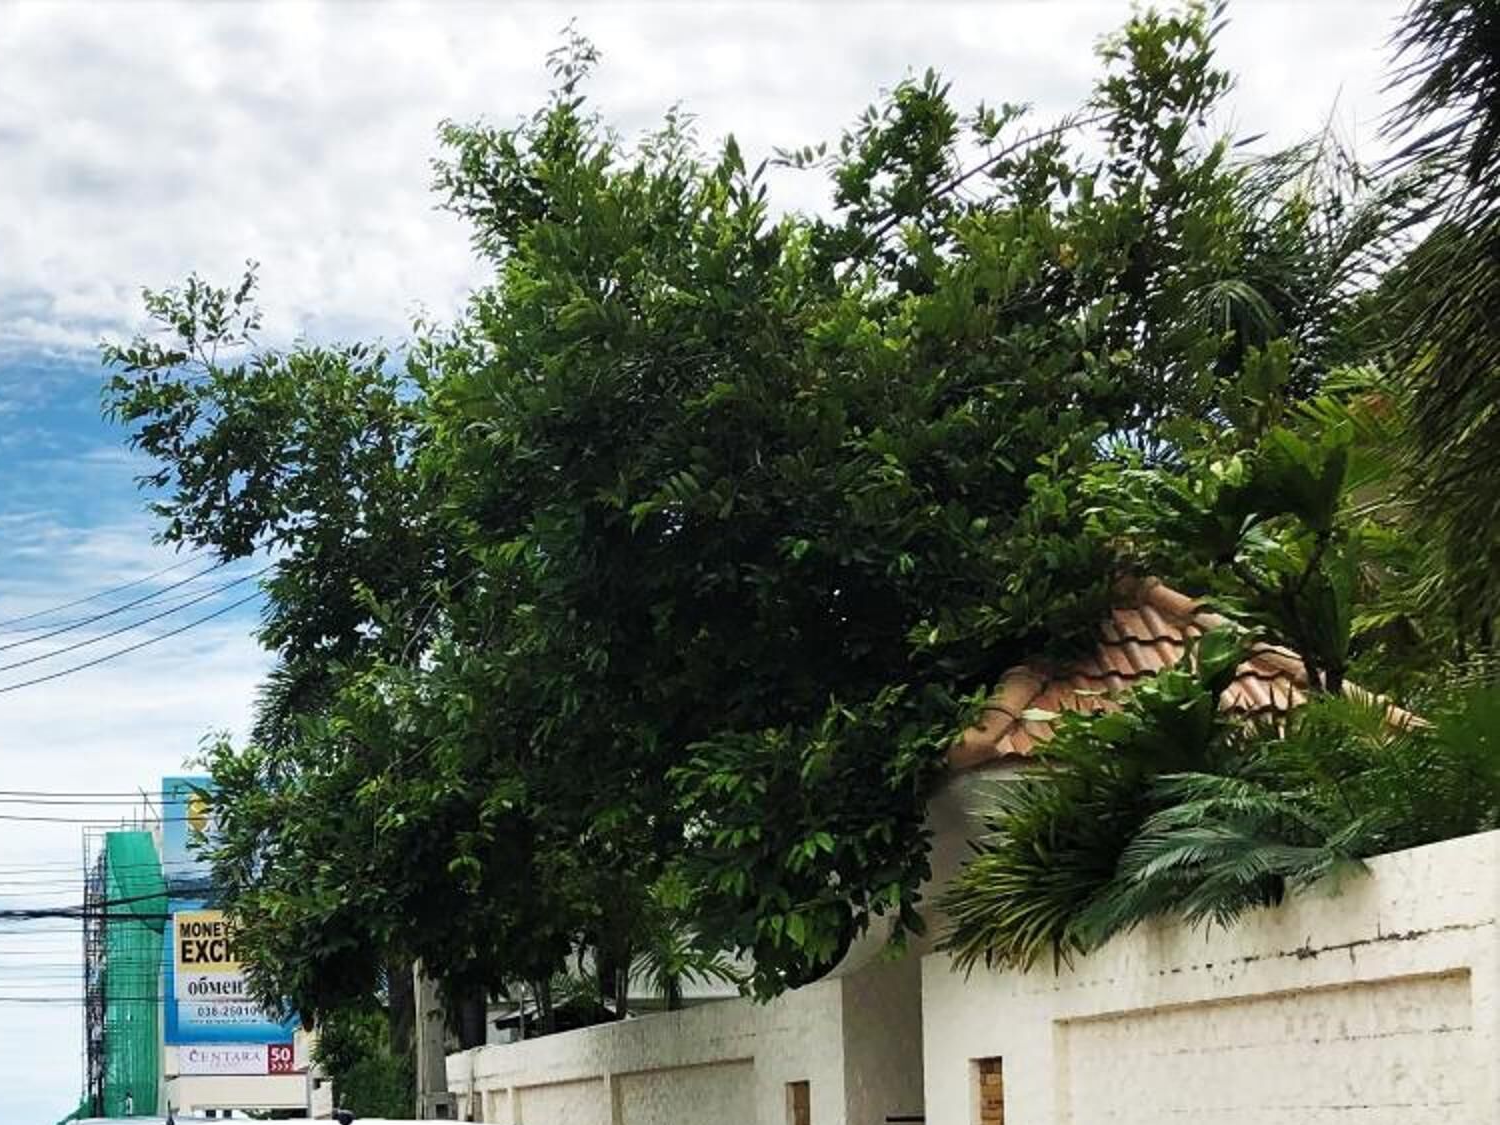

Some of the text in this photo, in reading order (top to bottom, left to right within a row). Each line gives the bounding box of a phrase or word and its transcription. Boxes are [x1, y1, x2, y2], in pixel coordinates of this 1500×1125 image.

[180, 922, 229, 937] MONEY
[182, 940, 244, 963] EXCH
[271, 1047, 291, 1061] 50
